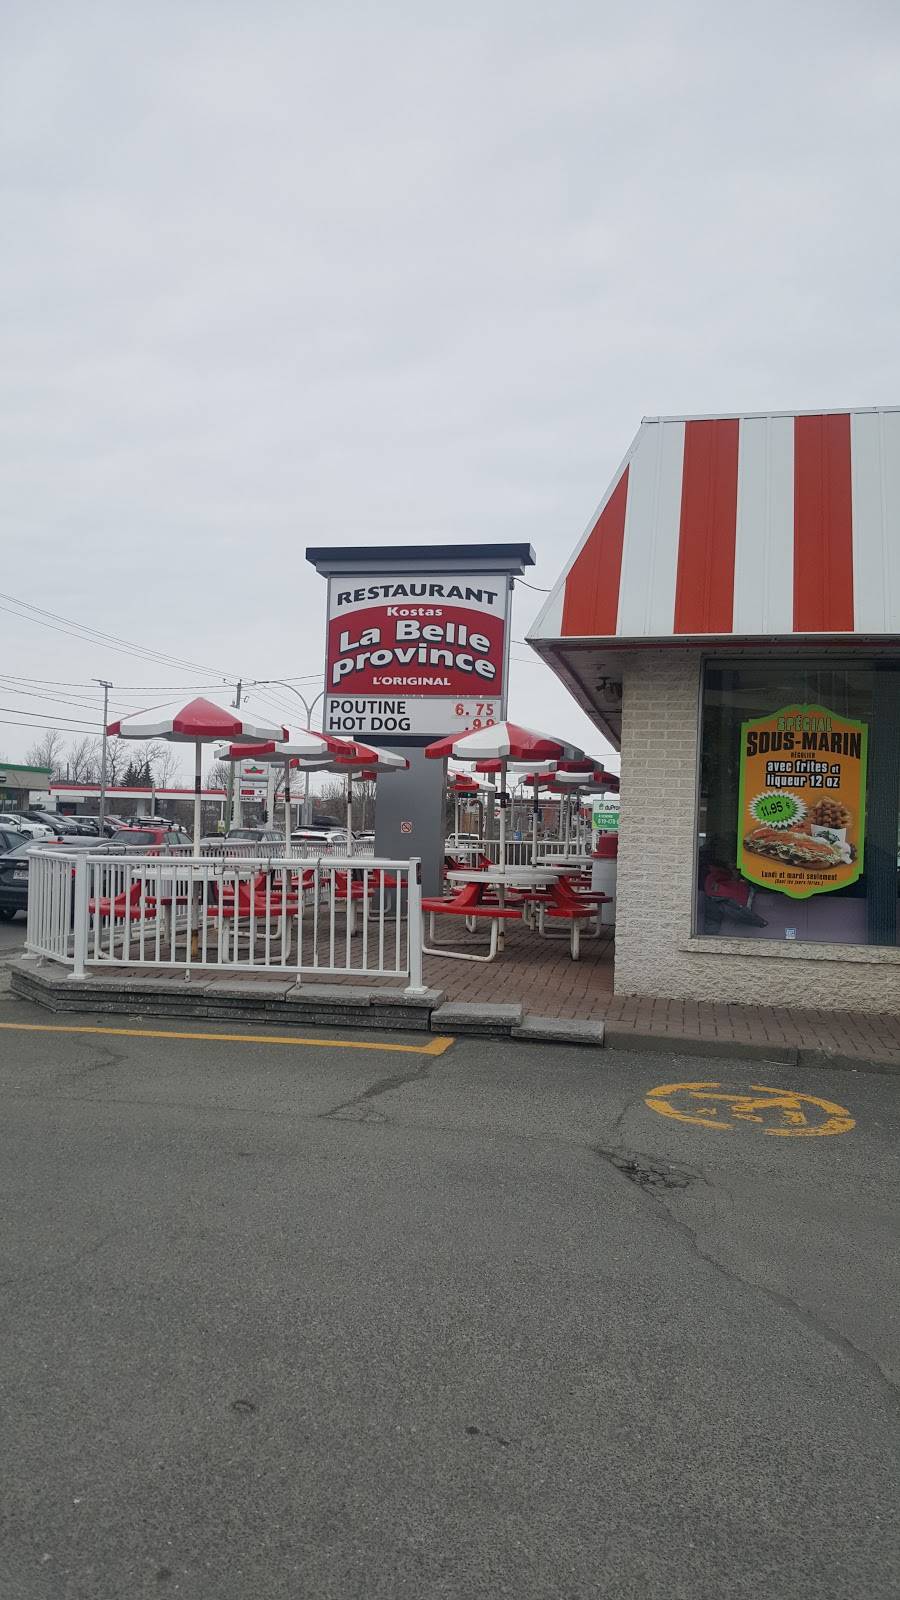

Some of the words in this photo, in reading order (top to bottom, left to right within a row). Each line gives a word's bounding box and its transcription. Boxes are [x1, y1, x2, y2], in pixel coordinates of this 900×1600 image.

[337, 583, 498, 606] RESTAURANT
[387, 606, 443, 617] Kostas
[339, 627, 381, 654] La
[395, 619, 491, 654] Belle
[332, 643, 497, 685] province
[372, 676, 451, 686] L'ORIGINAL
[330, 699, 406, 715] POUTINE
[455, 703, 494, 716] 6.75
[329, 716, 366, 731] HOT
[370, 716, 411, 731] DOG
[777, 715, 832, 731] SPÉCIAL
[746, 731, 862, 760] SOUS-MARIN
[767, 760, 793, 773] avec
[795, 760, 828, 773] frites
[831, 764, 839, 773] et
[766, 774, 807, 789] liqueur
[809, 775, 824, 787] 12
[826, 777, 839, 787] oz
